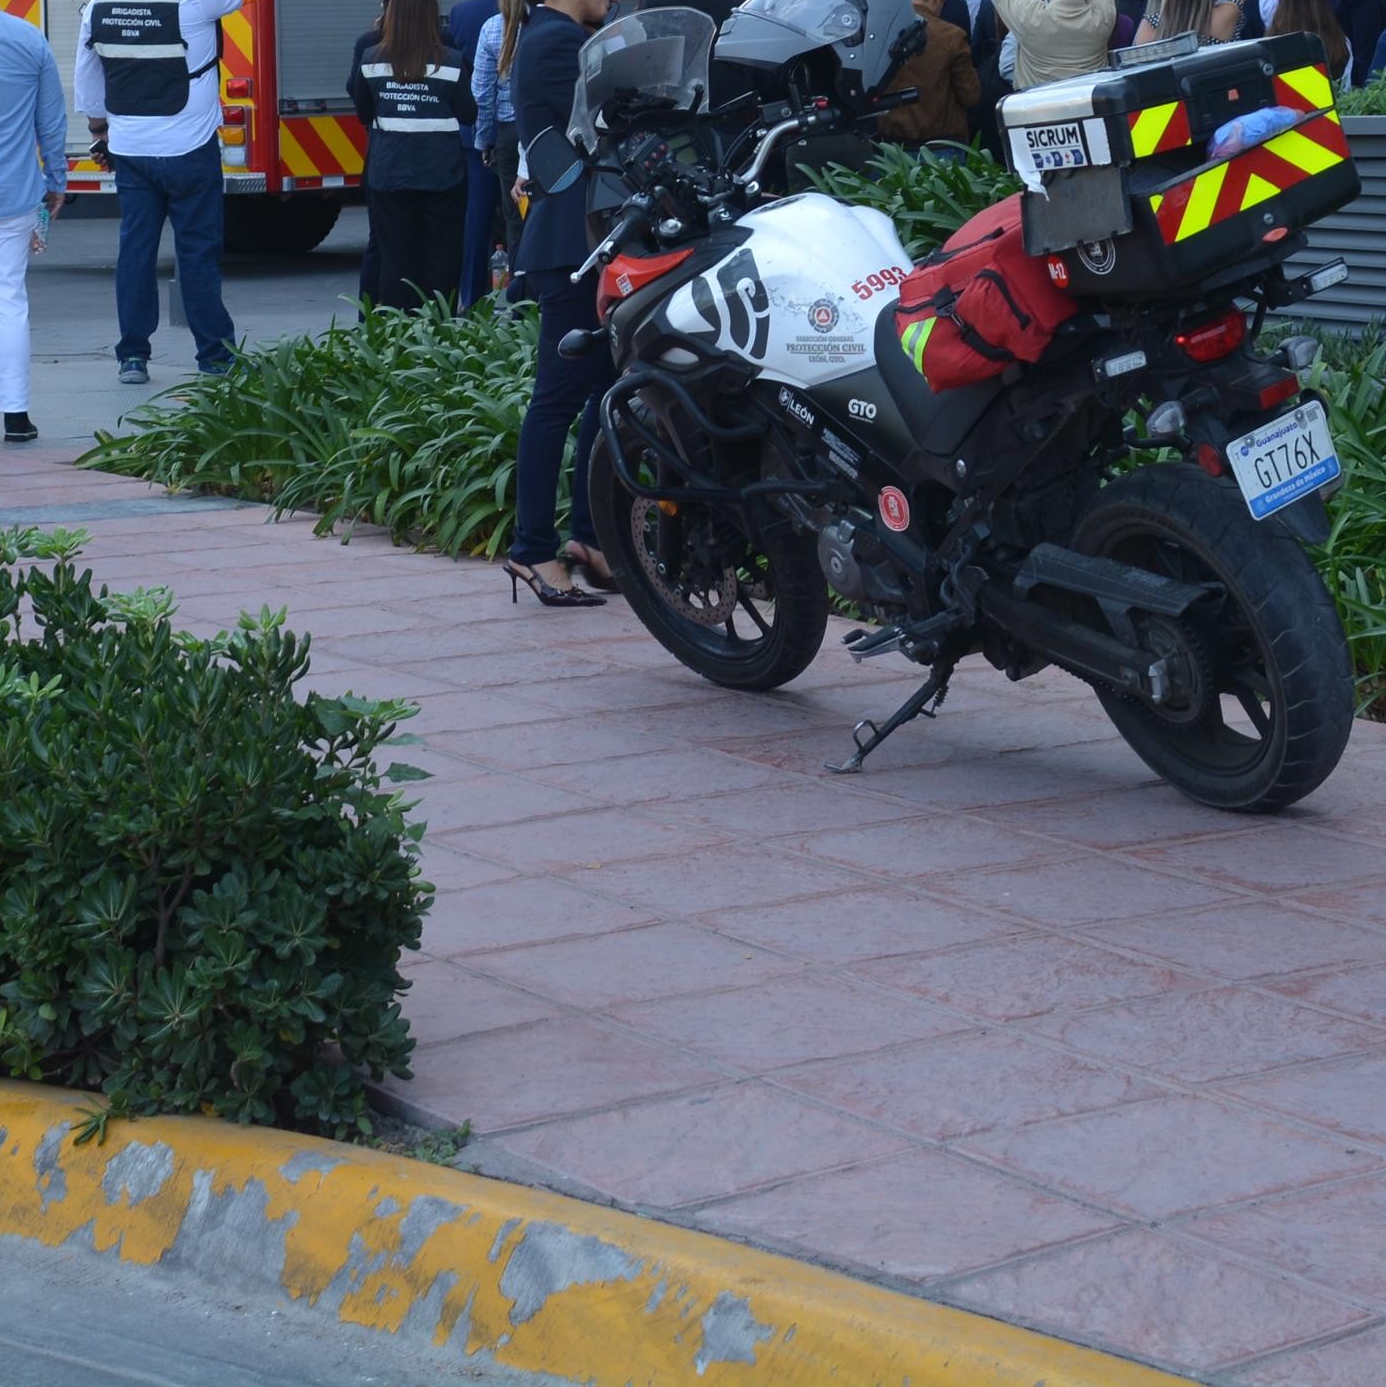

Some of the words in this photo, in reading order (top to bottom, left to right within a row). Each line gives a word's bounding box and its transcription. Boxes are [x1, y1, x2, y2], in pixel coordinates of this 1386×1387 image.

[111, 7, 152, 16] BRIGADISTA
[121, 29, 140, 37] BBVA
[144, 19, 162, 27] CIVIL
[421, 94, 440, 103] CIVIL
[1026, 126, 1080, 148] SICRUM
[851, 266, 907, 300] 5993
[786, 343, 841, 352] PROTECCIÓN
[842, 344, 867, 352] CIVIL
[789, 398, 815, 426] LEÓN
[848, 398, 877, 419] GTO
[1256, 421, 1298, 448] Guanajuato
[1254, 430, 1320, 489] GT76X
